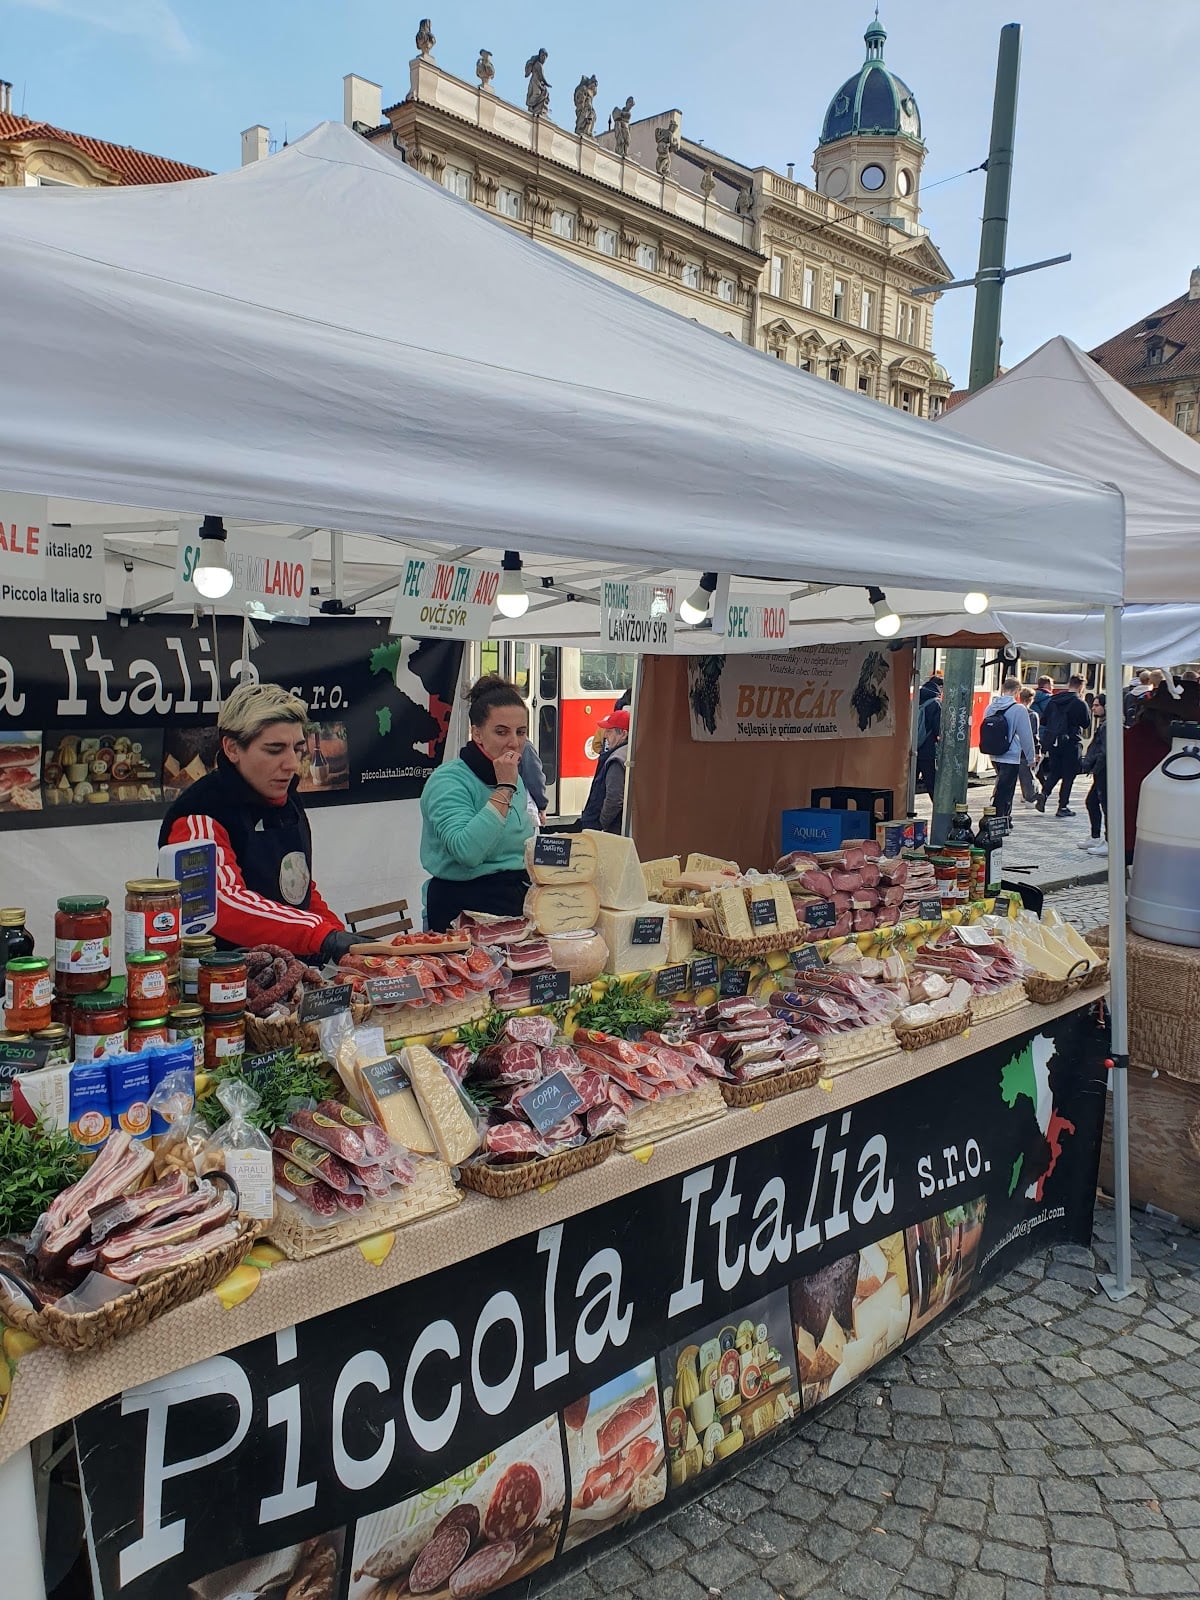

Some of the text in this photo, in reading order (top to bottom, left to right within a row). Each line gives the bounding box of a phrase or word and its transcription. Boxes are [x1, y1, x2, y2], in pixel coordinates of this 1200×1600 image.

[46, 542, 92, 559] italia02
[2, 585, 102, 604] Piccola Italia sro
[420, 603, 467, 626] OVČÍ SÝR
[653, 615, 667, 644] SÝR
[736, 680, 845, 720] BURČÁK
[737, 722, 838, 737] Nejlepší je přímo od vinaře
[361, 766, 437, 783] piccolaitalia02@gm
[793, 827, 828, 840] AQUILA
[373, 978, 405, 987] SALAME
[532, 1085, 561, 1109] COPPA
[232, 1165, 268, 1174] TARALLI
[119, 1112, 992, 1588] Piccola Italia s.r.o.
